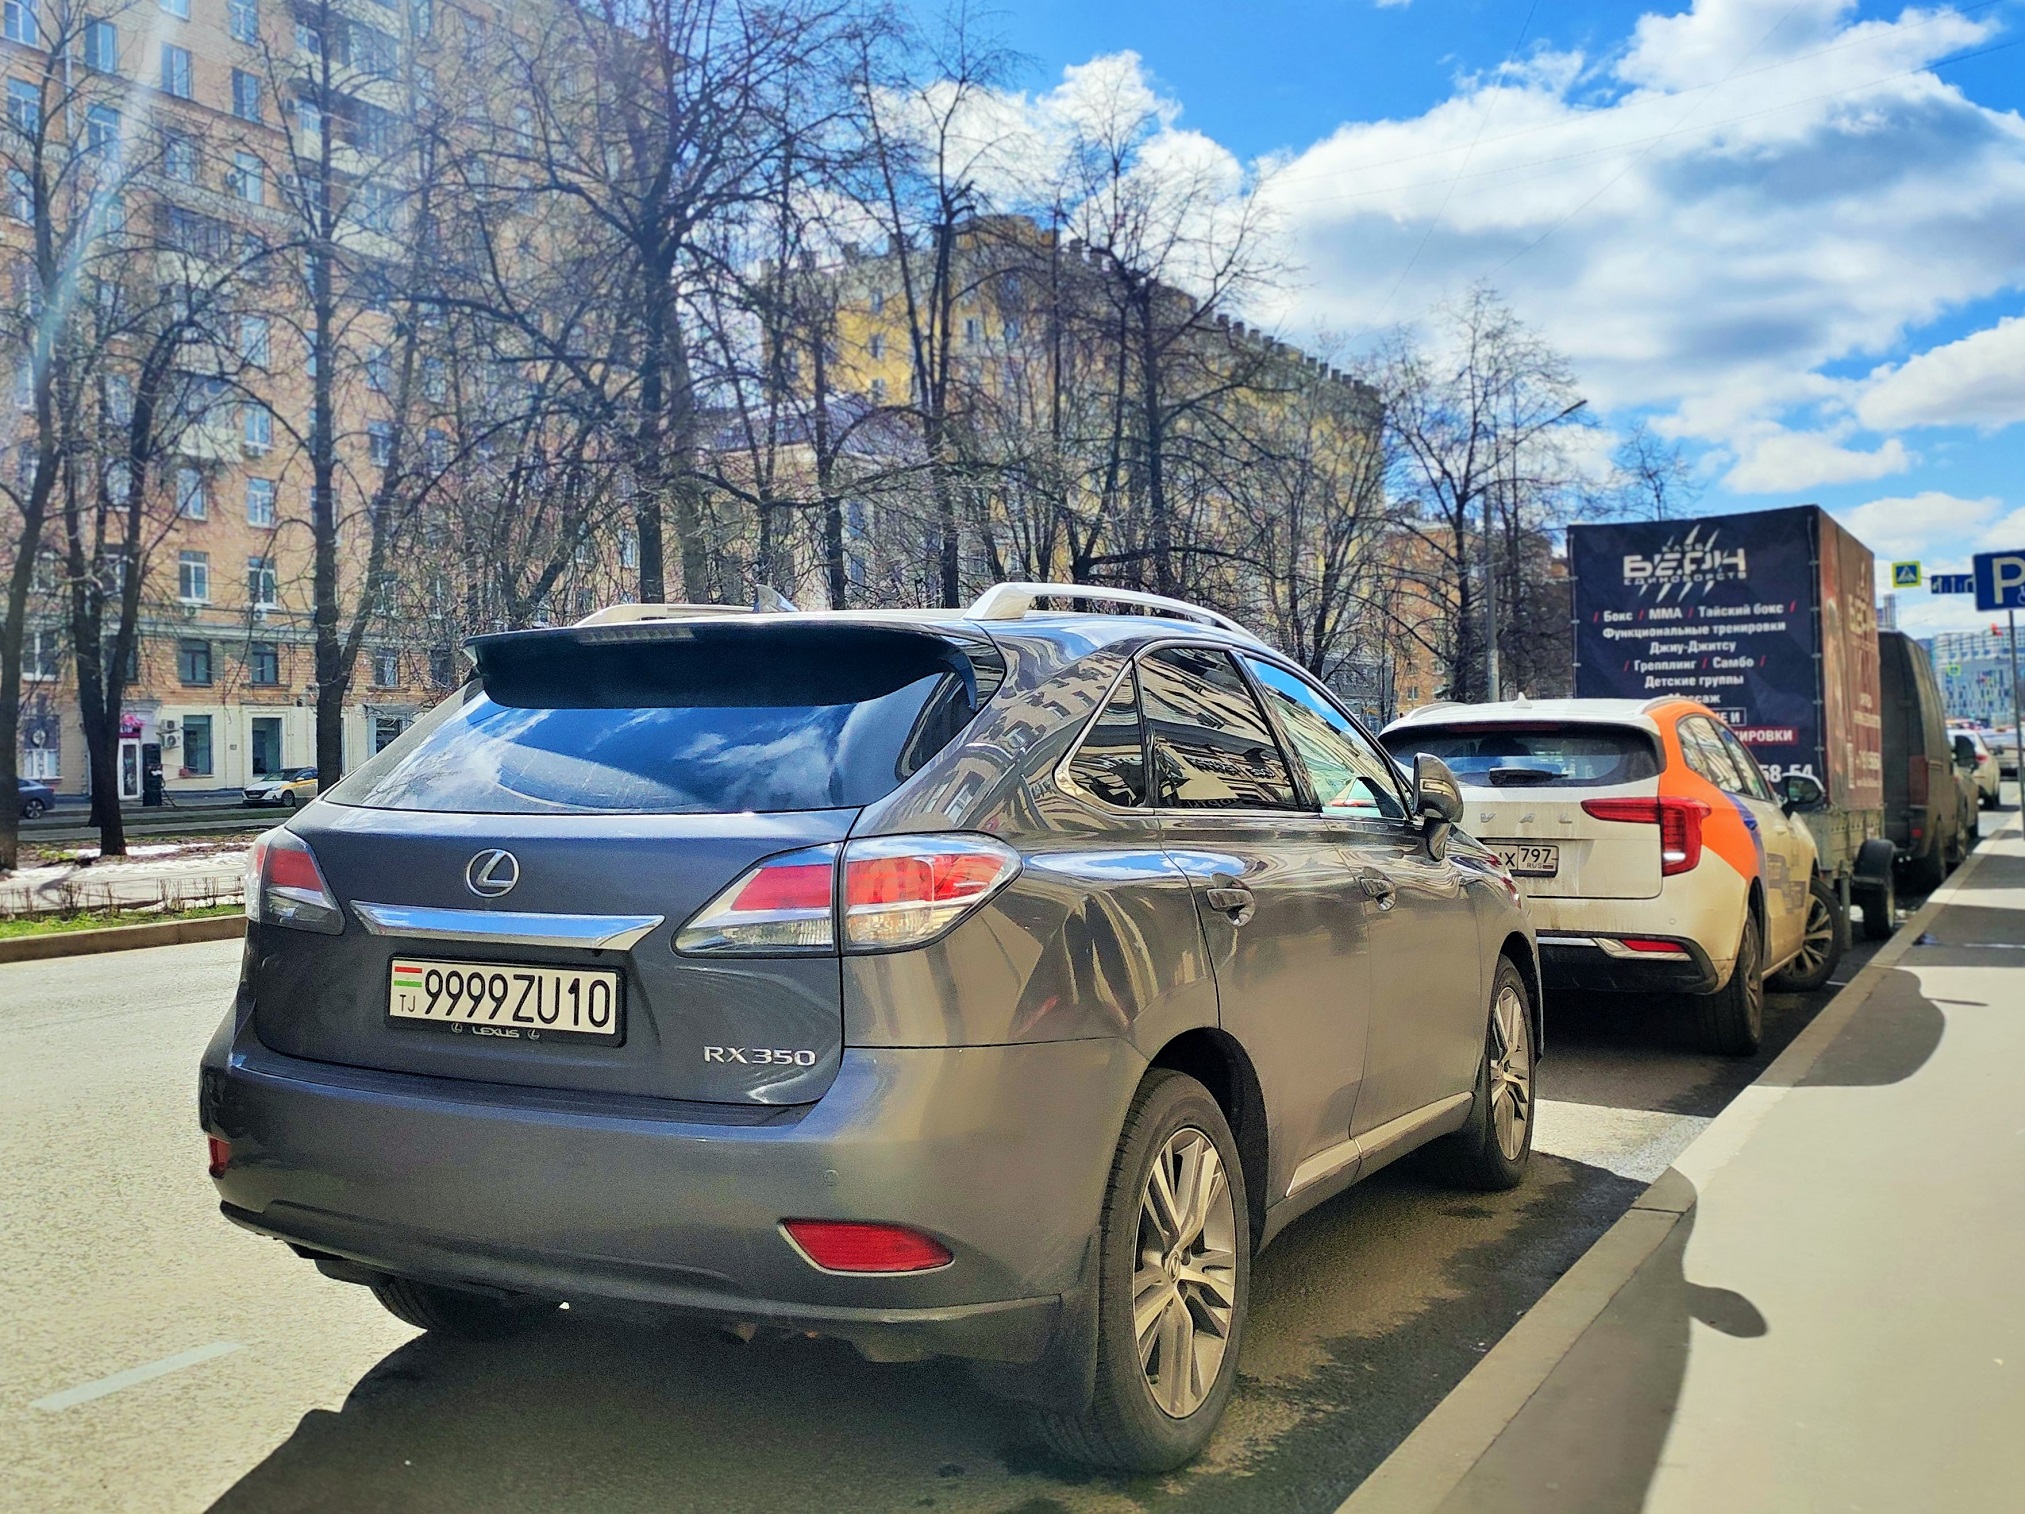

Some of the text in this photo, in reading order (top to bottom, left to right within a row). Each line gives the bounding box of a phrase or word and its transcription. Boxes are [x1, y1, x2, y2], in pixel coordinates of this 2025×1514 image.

[1992, 556, 2025, 604] P
[1603, 610, 1633, 622] Бокс
[1698, 603, 1750, 618] Тайский
[1753, 603, 1784, 615] бокс
[1602, 621, 1786, 640] Функциональные тренировки
[1649, 640, 1736, 655] Джиу-Джитсу
[1634, 656, 1754, 673] Грепплинг Самбо
[1644, 674, 1744, 689] Детские группы
[1735, 729, 1793, 742] ИРОВКИ
[1521, 848, 1551, 863] 797
[399, 994, 416, 1013] TJ
[424, 968, 611, 1028] 9999ZU10
[472, 1026, 520, 1039] LEXUS
